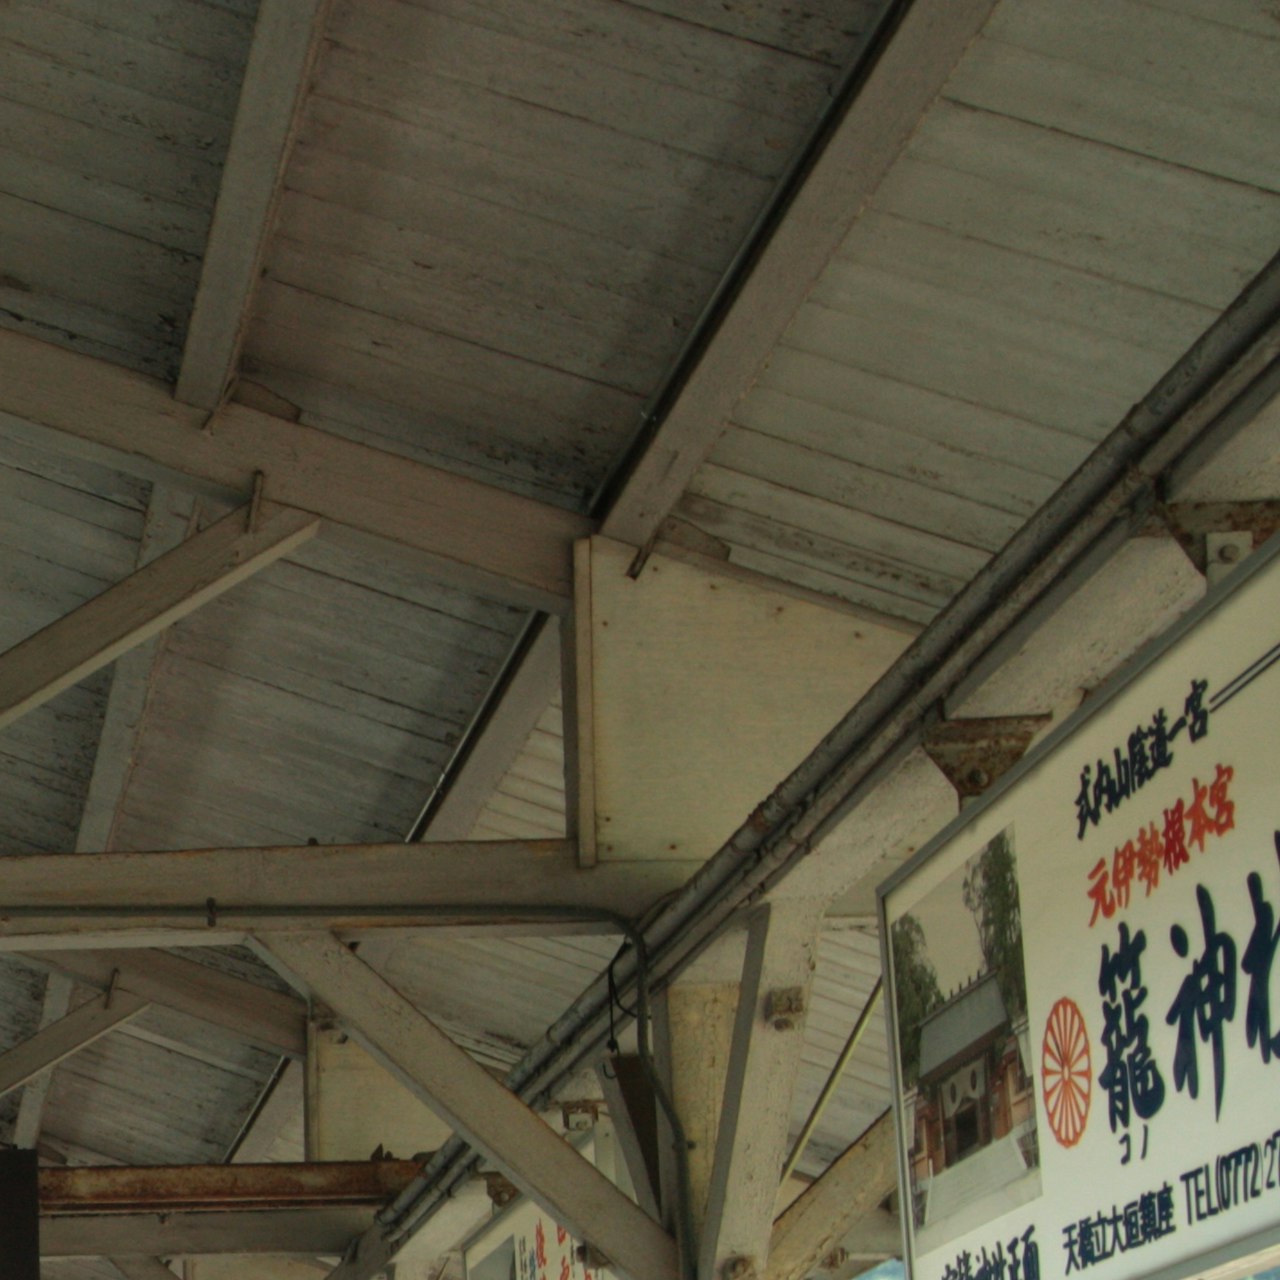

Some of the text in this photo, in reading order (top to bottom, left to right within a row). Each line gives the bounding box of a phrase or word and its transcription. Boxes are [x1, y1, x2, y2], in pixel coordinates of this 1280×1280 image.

[1087, 762, 1236, 928] 元伊勢根本宮
[1061, 1181, 1177, 1276] 天橋立大垣鎮座
